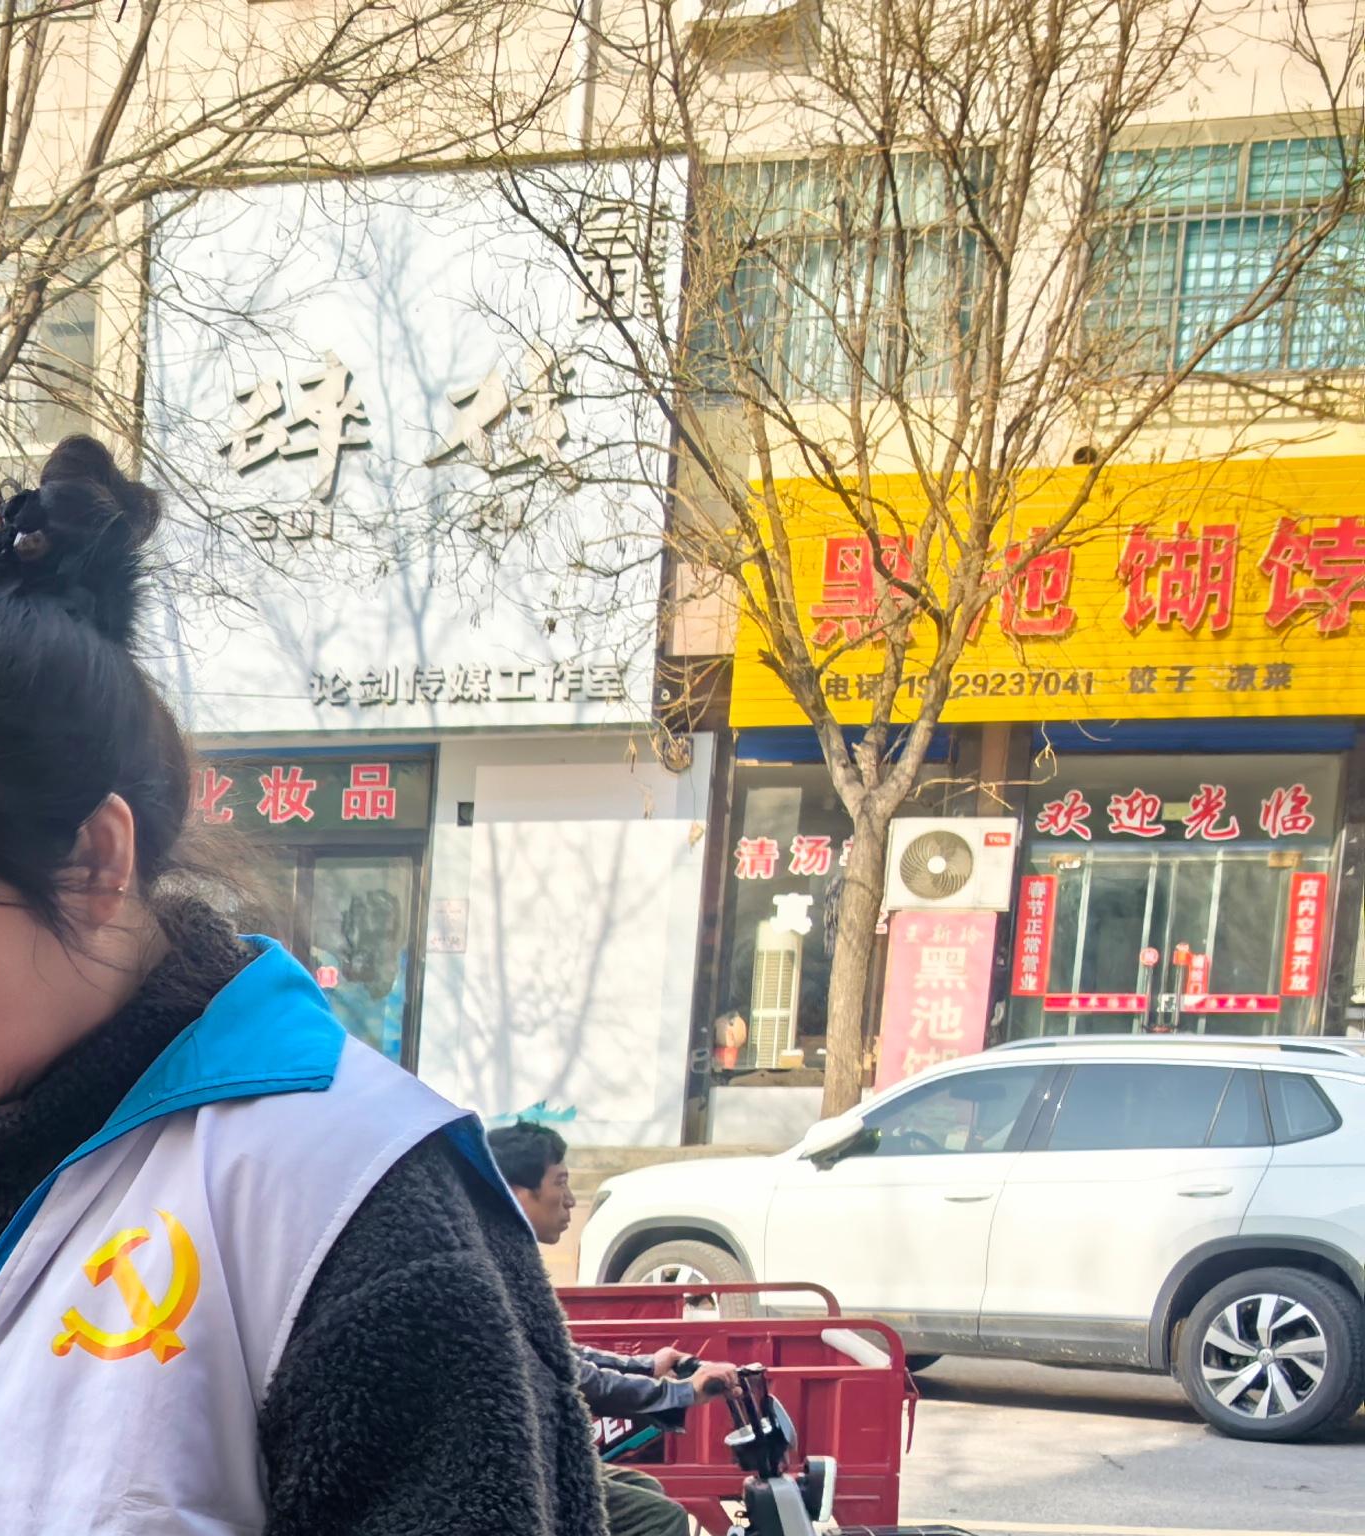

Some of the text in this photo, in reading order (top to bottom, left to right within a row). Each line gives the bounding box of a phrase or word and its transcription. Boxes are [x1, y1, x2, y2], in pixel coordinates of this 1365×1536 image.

[908, 670, 1095, 698] 1929237041
[1036, 784, 1318, 842] 欢迎光临
[734, 835, 855, 880] 清汤
[1017, 878, 1047, 994] 春节正常营业
[1288, 877, 1320, 993] 店内空调开放
